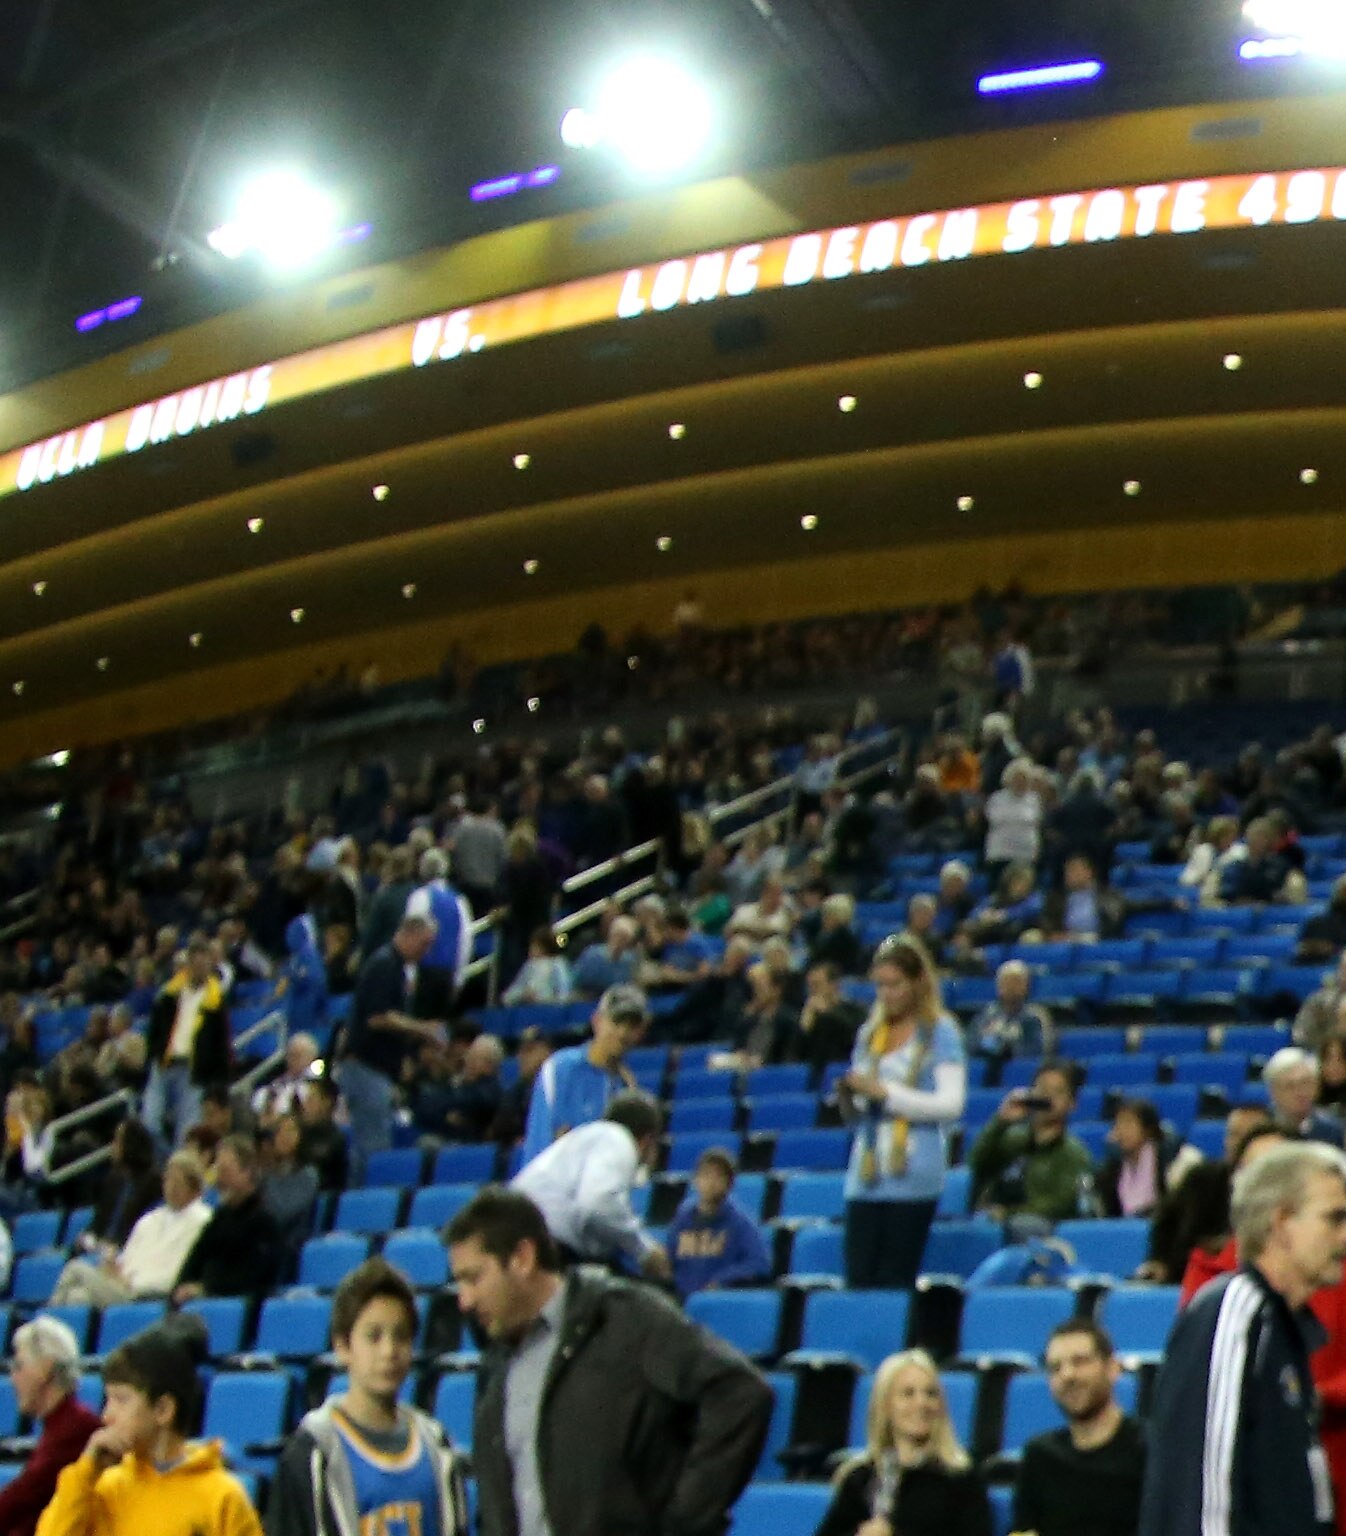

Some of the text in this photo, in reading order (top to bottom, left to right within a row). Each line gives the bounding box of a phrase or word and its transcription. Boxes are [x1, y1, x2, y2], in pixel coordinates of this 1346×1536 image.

[16, 421, 104, 491] UCLA
[126, 365, 273, 453] BRUINS
[411, 308, 486, 368] VS.
[617, 243, 763, 319] LONG
[783, 208, 978, 287] BEACH
[1002, 181, 1210, 254] STATE
